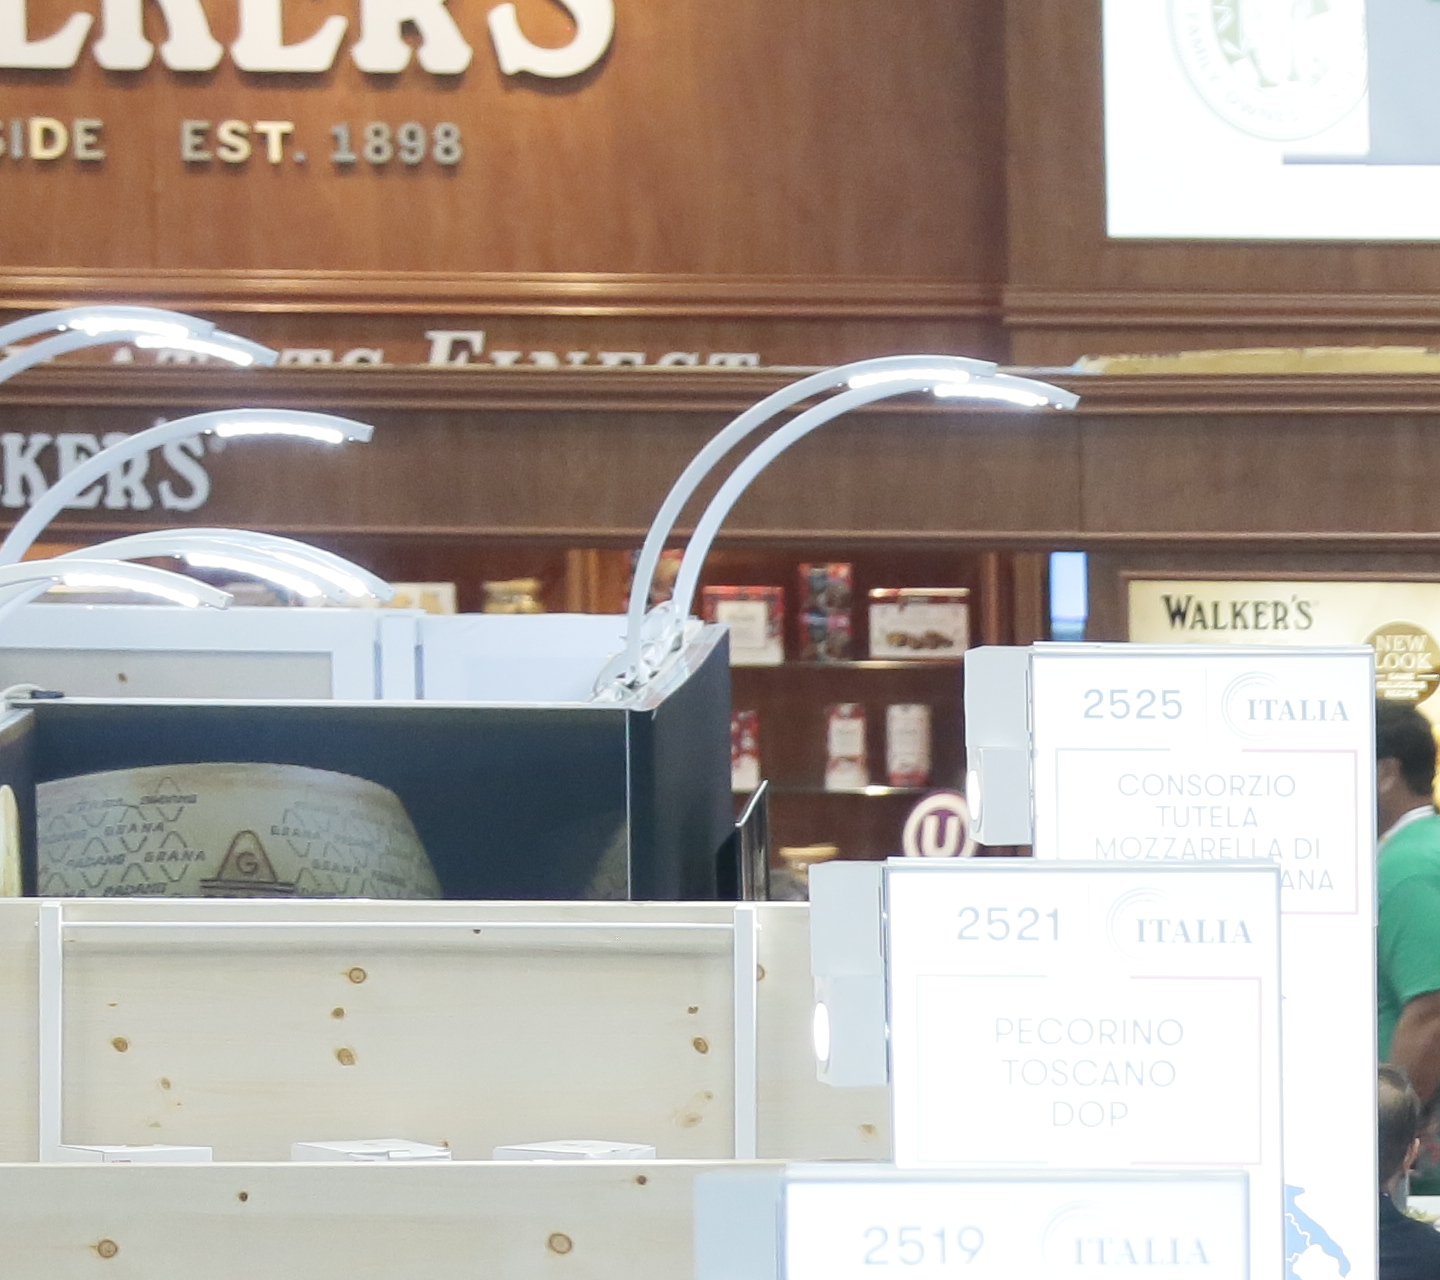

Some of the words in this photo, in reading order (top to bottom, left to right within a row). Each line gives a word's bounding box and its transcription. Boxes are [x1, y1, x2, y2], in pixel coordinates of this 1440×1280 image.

[181, 120, 306, 164] EST.
[330, 122, 463, 166] 1898
[1162, 594, 1313, 630] WALKER'S
[1376, 634, 1428, 652] NEW
[1083, 688, 1183, 719] 2525
[1247, 698, 1350, 722] ITALIA
[1117, 772, 1297, 798] CONSORZIO
[1156, 805, 1259, 828] TUTELA
[1096, 837, 1284, 861] MOZZARELLA
[1295, 837, 1321, 860] DI
[956, 905, 1060, 942] 2521
[1135, 918, 1253, 945] ITALIA
[994, 1017, 1185, 1047] PECORINO
[1001, 1058, 1177, 1088] TOSCANO
[1052, 1100, 1129, 1128] DOP
[861, 1224, 986, 1266] 2519
[1073, 1236, 1212, 1267] ITALIA
